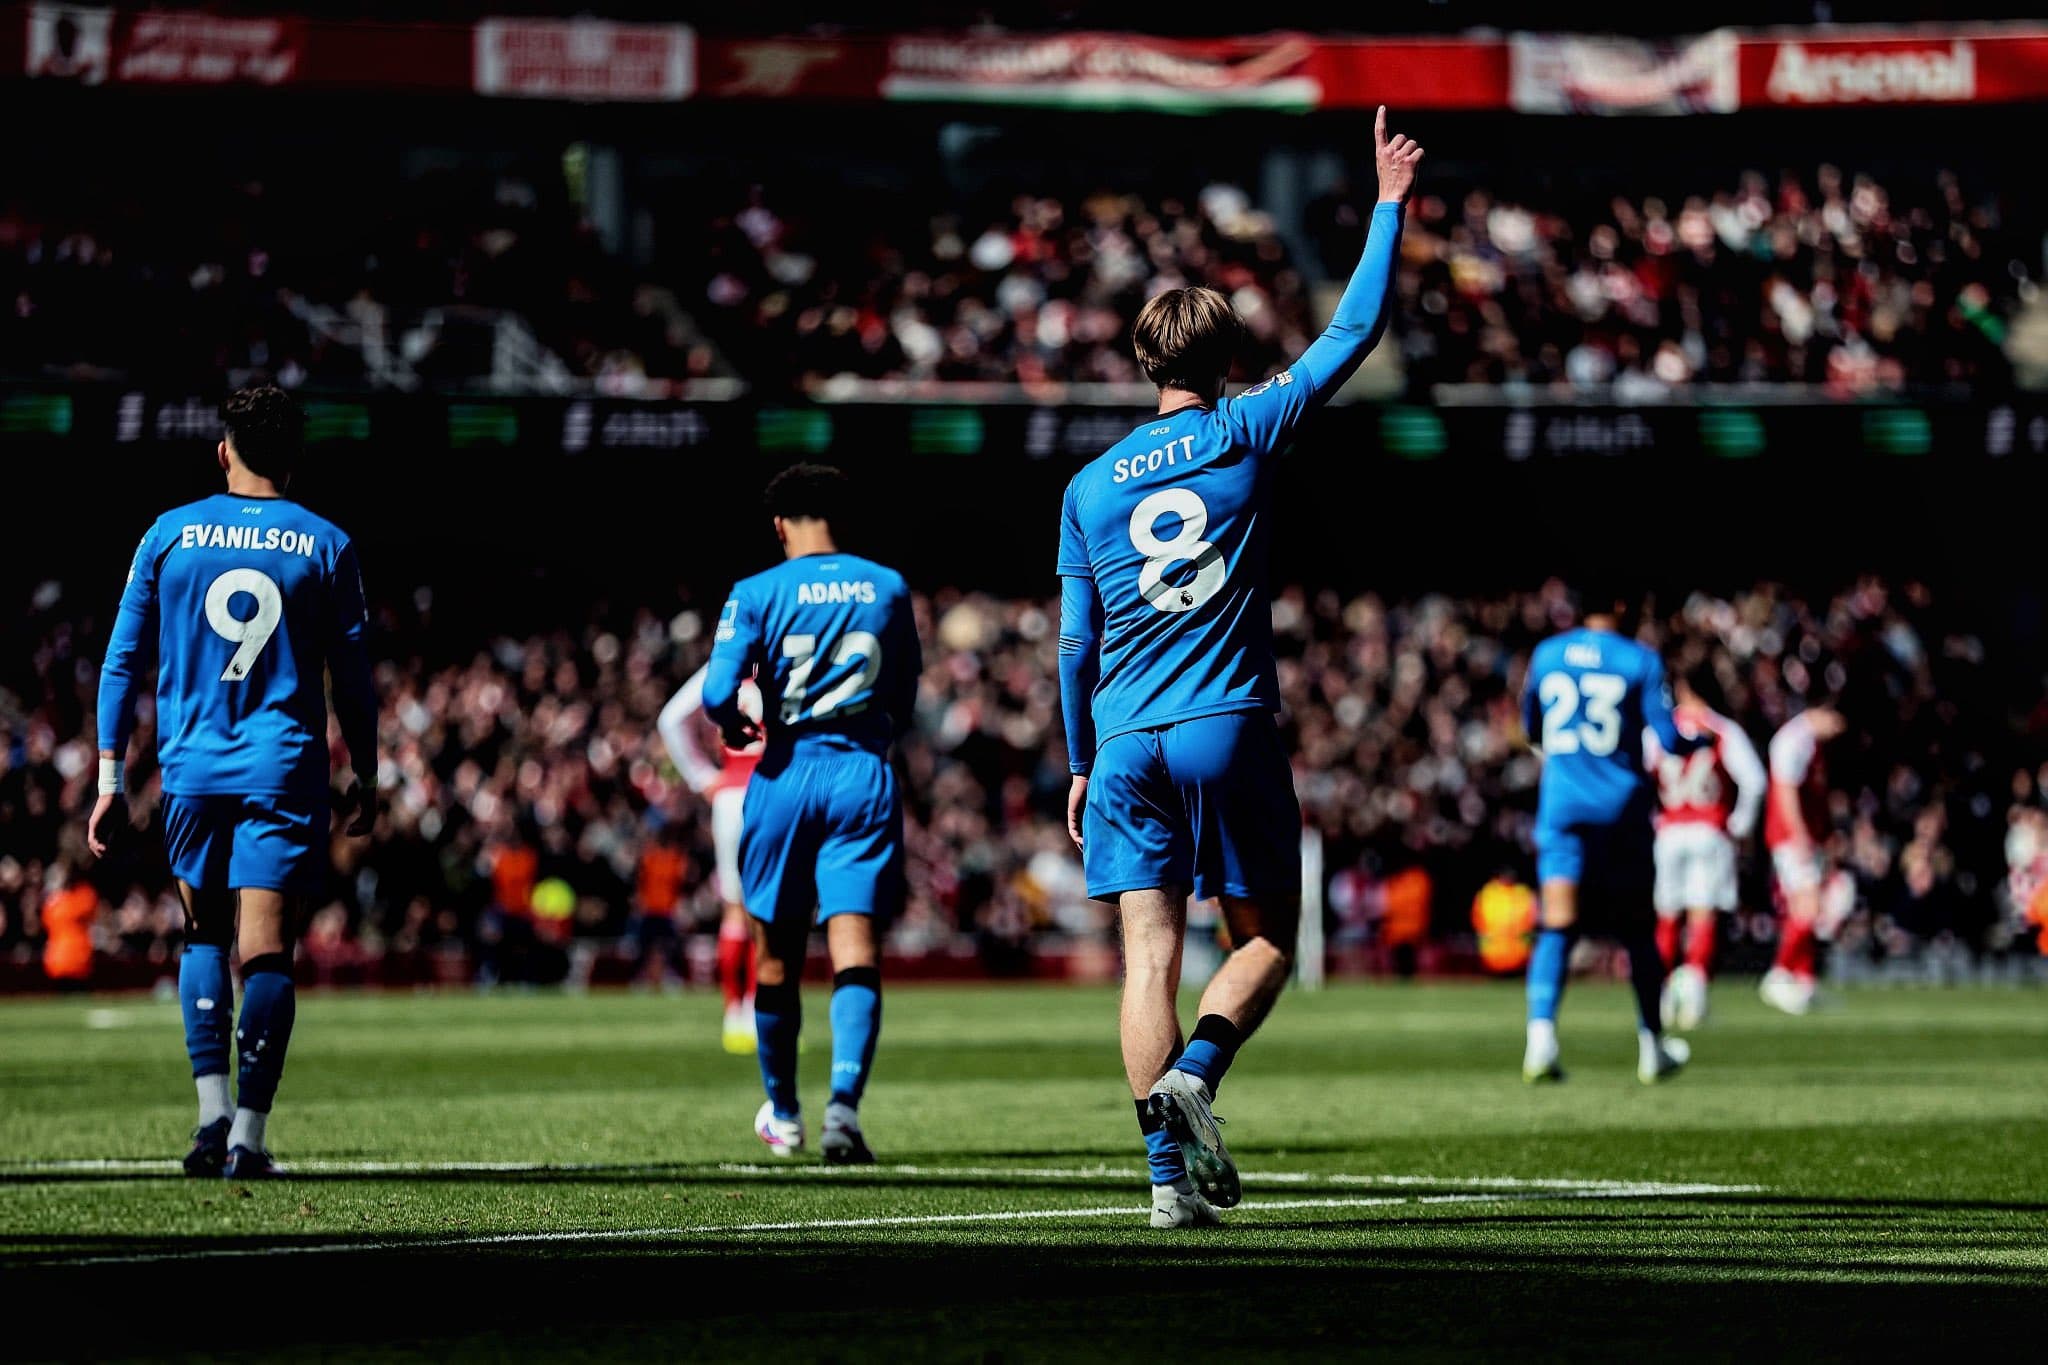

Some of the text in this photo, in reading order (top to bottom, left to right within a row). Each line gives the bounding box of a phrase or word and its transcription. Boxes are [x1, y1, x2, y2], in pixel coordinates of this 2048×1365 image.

[1767, 39, 1977, 101] Arsenal
[1112, 435, 1196, 484] SCOTT
[181, 524, 315, 557] EVANILSON
[1129, 487, 1226, 613] 8
[797, 581, 877, 605] ADAMS
[204, 568, 283, 682] 9
[1539, 670, 1627, 757] 23
